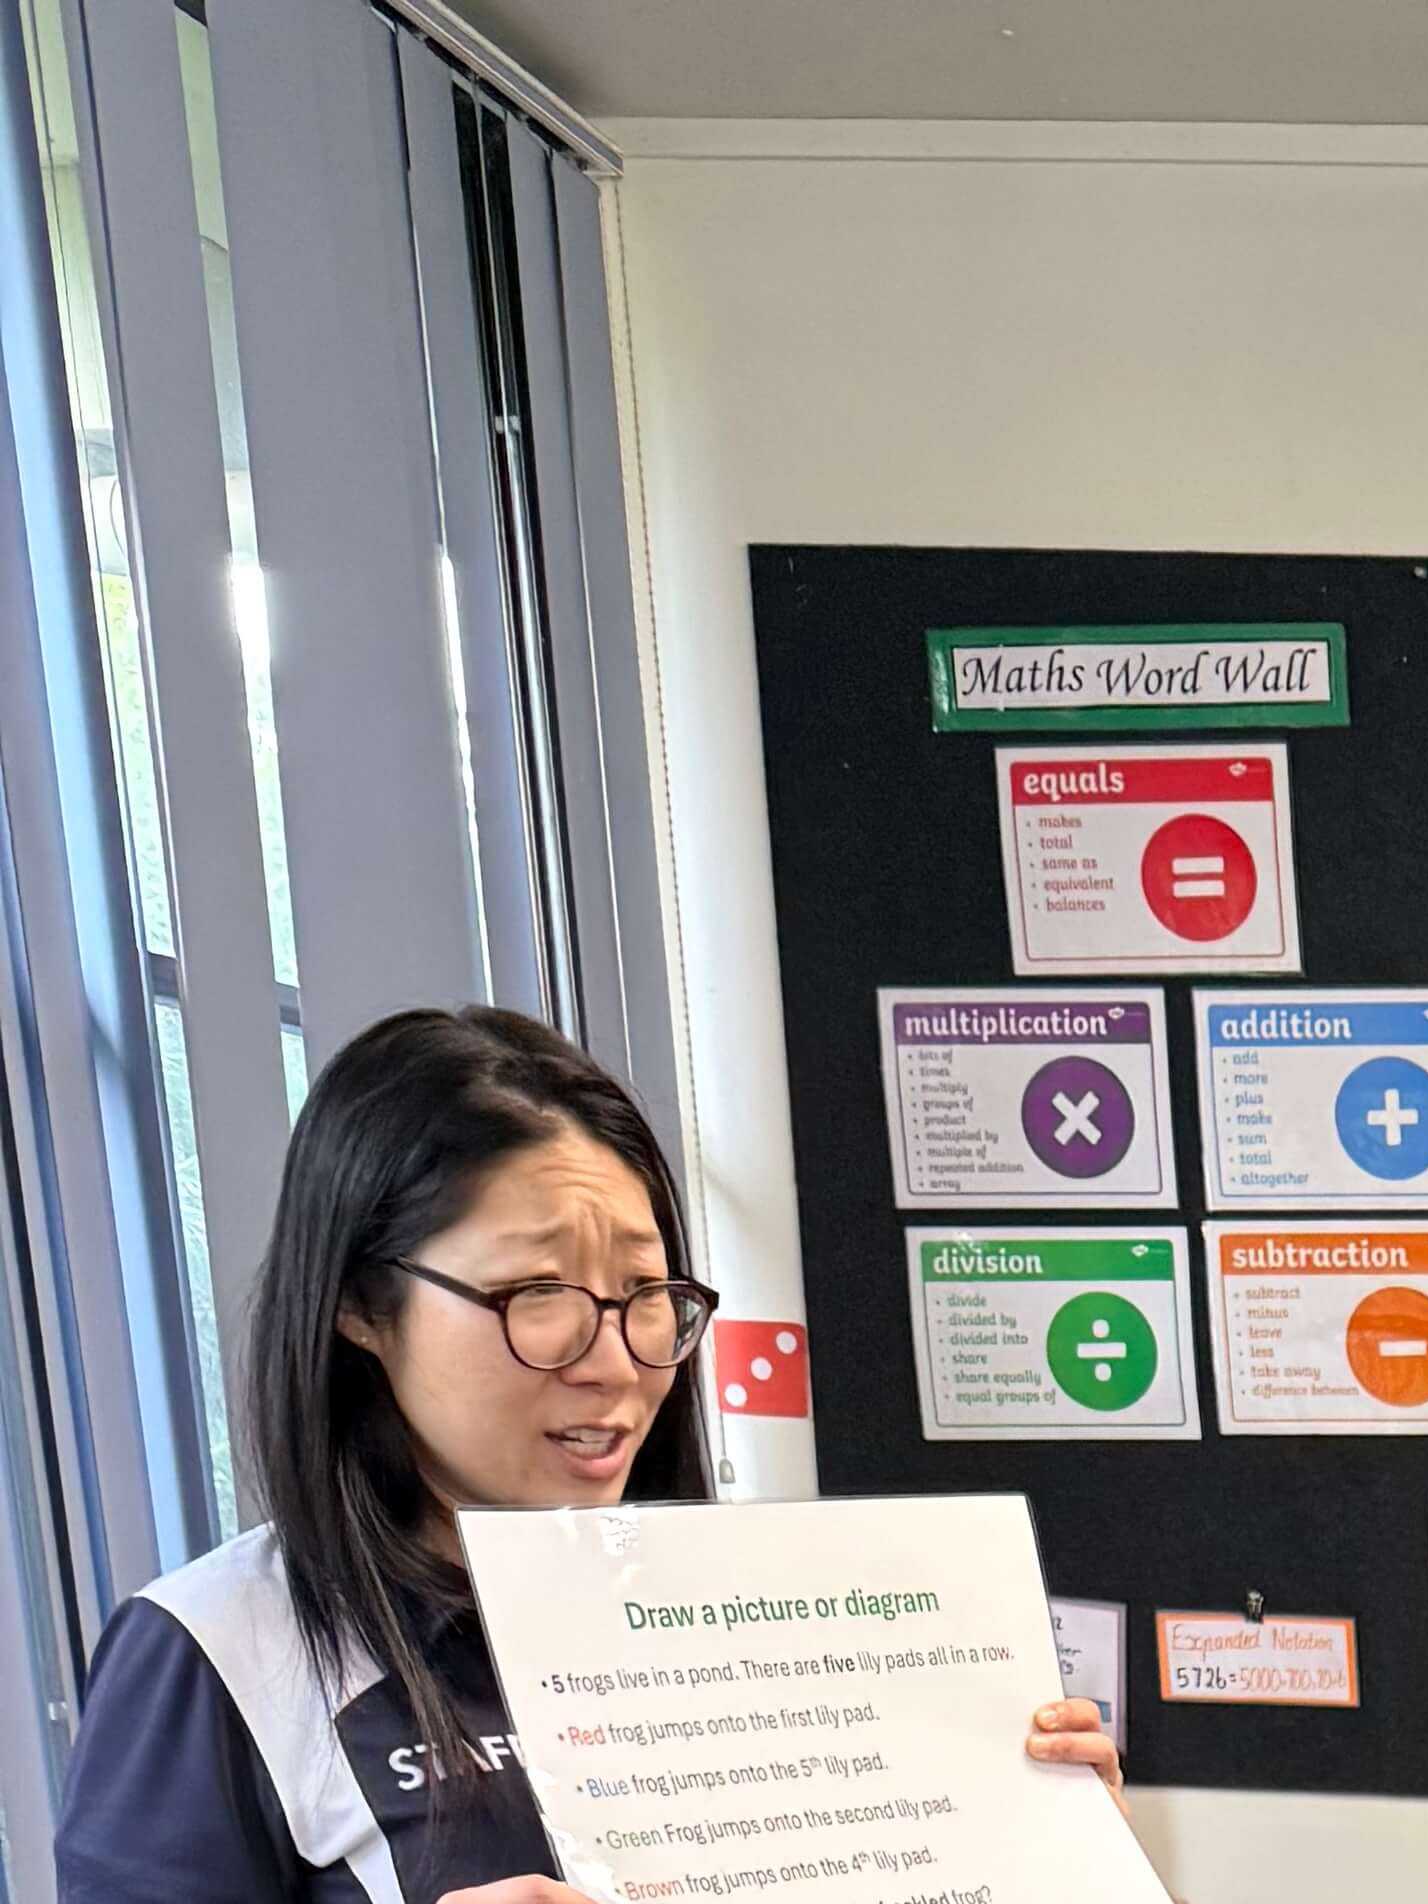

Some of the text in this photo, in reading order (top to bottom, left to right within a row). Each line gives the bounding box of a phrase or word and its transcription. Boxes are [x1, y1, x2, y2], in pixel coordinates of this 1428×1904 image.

[962, 650, 1316, 696] Maths Word Wall
[1024, 762, 1124, 801] equals
[1039, 815, 1082, 828] makes
[1040, 834, 1072, 849] total
[1042, 857, 1097, 869] same as
[1044, 875, 1113, 893] equivalent
[1046, 897, 1105, 911] balances
[905, 1008, 1108, 1044] multiplication
[1221, 1011, 1351, 1039] addition
[1233, 1051, 1258, 1064] add
[1234, 1074, 1268, 1084] more
[1235, 1091, 1263, 1107] plus
[1237, 1110, 1272, 1124] make
[1238, 1134, 1267, 1144] sum
[1240, 1150, 1272, 1165] total
[1241, 1171, 1309, 1188] altogether
[1232, 1239, 1408, 1269] subtraction
[933, 1250, 1043, 1275] division
[947, 1293, 986, 1306] divide
[949, 1313, 1016, 1328] divided by
[950, 1332, 1028, 1345] divided into
[953, 1351, 987, 1364] share
[955, 1370, 1041, 1386] share equally
[1284, 1366, 1321, 1380] away
[956, 1388, 1056, 1406] equal groups of
[624, 1588, 940, 1631] Draw a picture or diagram
[1171, 1624, 1333, 1664] Expanded Notation
[551, 1645, 1016, 1696] 5 frogs live in a pond. There are five lily pads all in a row.
[567, 1702, 881, 1746] Red frog jumps onto the first lily pad.
[586, 1778, 630, 1799] Blue
[631, 1774, 671, 1797] frog
[668, 1769, 726, 1795] jumps
[728, 1765, 768, 1785] onto
[770, 1761, 799, 1781] the
[824, 1753, 849, 1778] lily
[852, 1752, 889, 1777] pad.
[606, 1795, 959, 1849] Green Frog jumps onto the second lily pad.
[624, 1878, 685, 1901] Brown
[685, 1873, 724, 1896] frog
[722, 1866, 778, 1893] jumps
[780, 1860, 819, 1882] onto
[820, 1857, 849, 1877] the
[872, 1848, 899, 1873] lily
[901, 1846, 939, 1870] pad.
